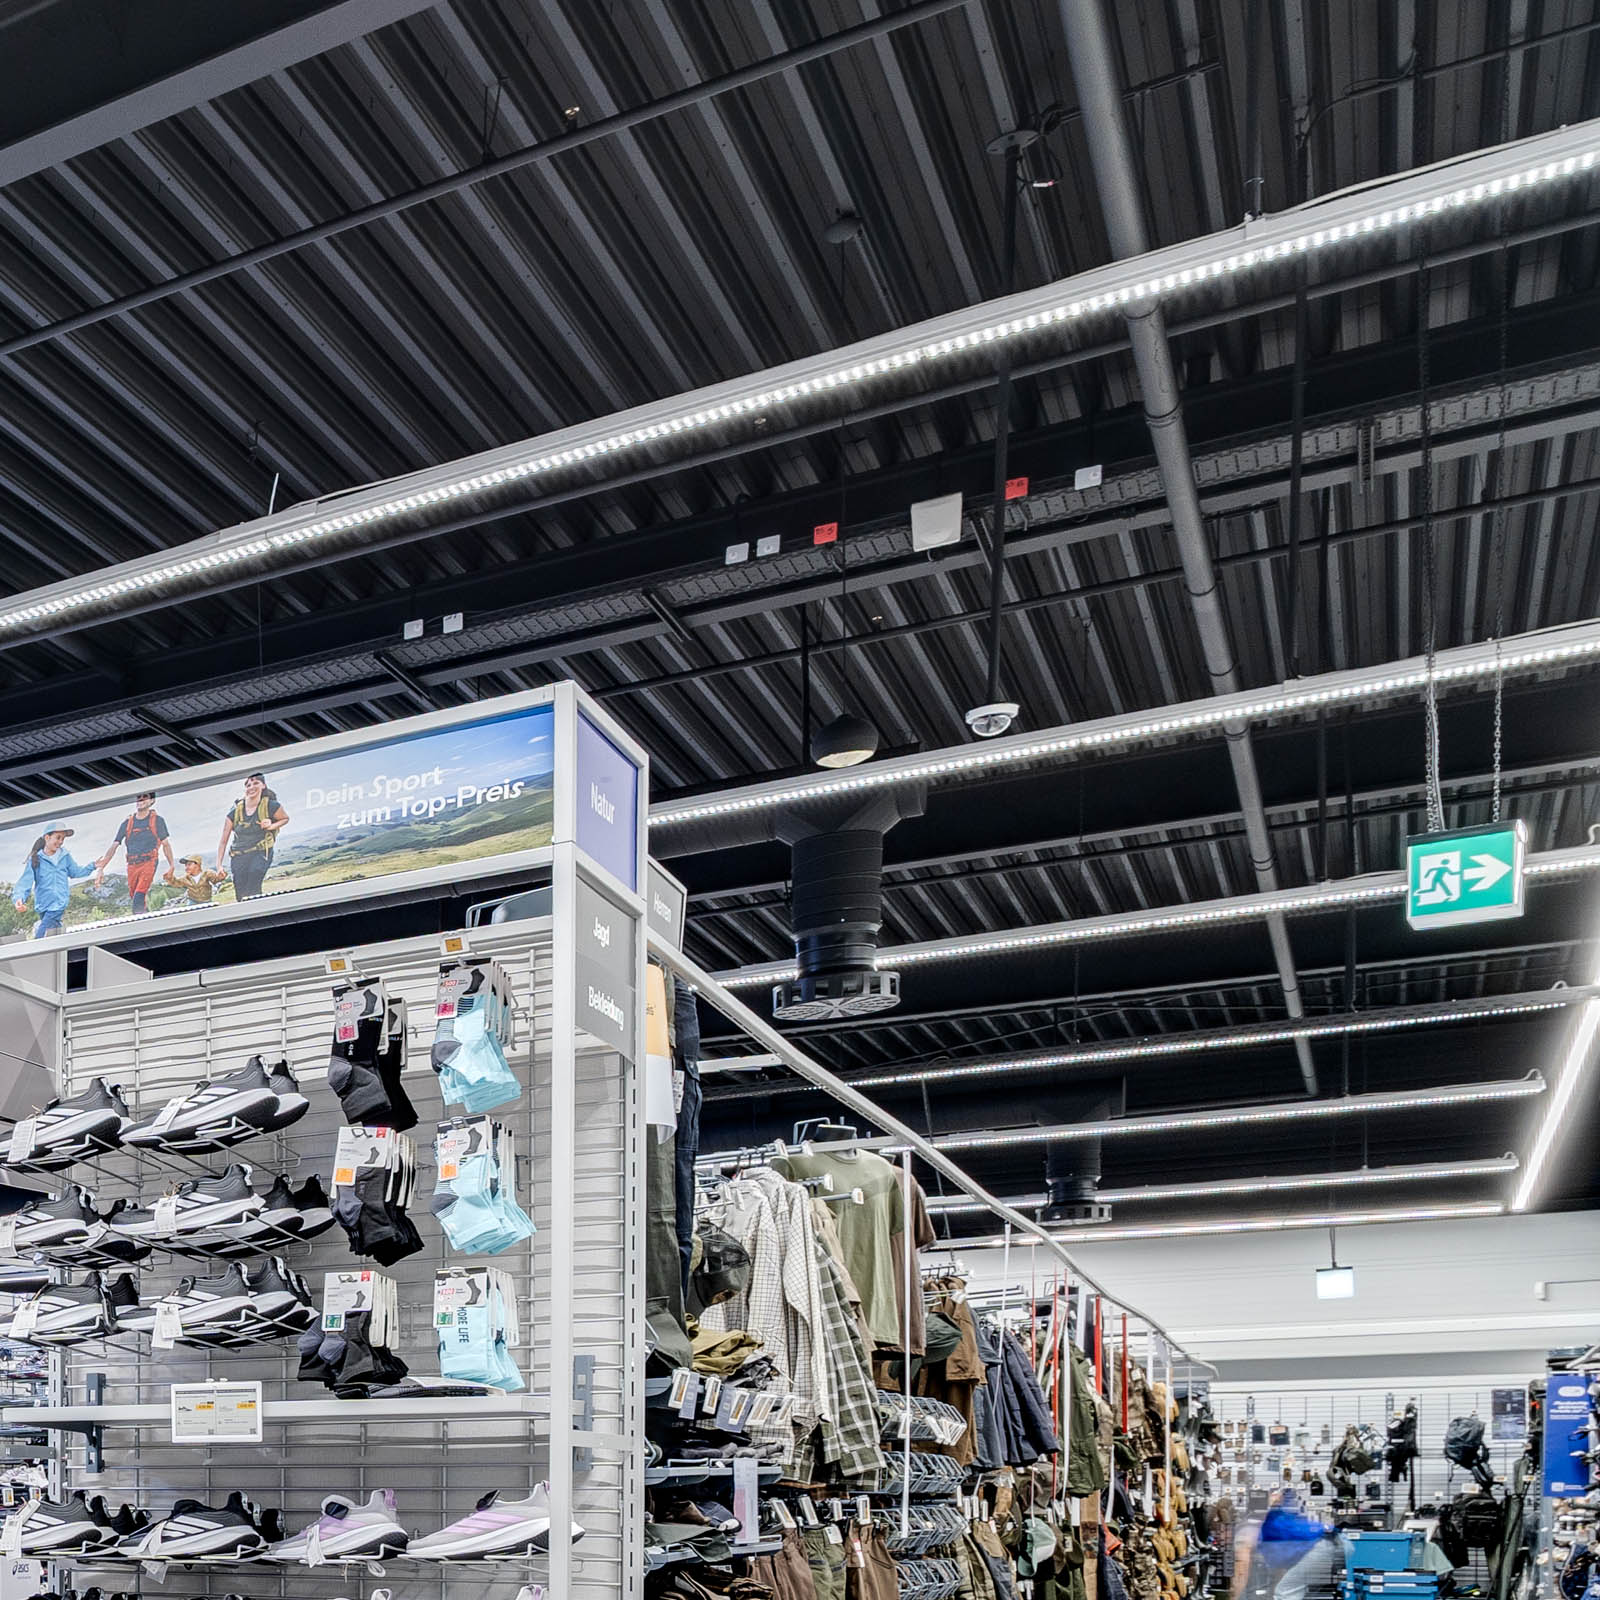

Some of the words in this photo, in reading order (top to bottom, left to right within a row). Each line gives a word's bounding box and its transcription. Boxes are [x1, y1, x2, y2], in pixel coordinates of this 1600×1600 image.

[305, 783, 364, 809] Dein
[368, 766, 442, 799] Sport
[337, 806, 391, 829] zum
[396, 778, 525, 818] Top-Preis
[590, 782, 615, 824] Natur
[653, 891, 671, 923] Herren
[593, 916, 610, 948] Jagd
[588, 985, 624, 1031] Bekleidung
[459, 1328, 469, 1343] LIFE
